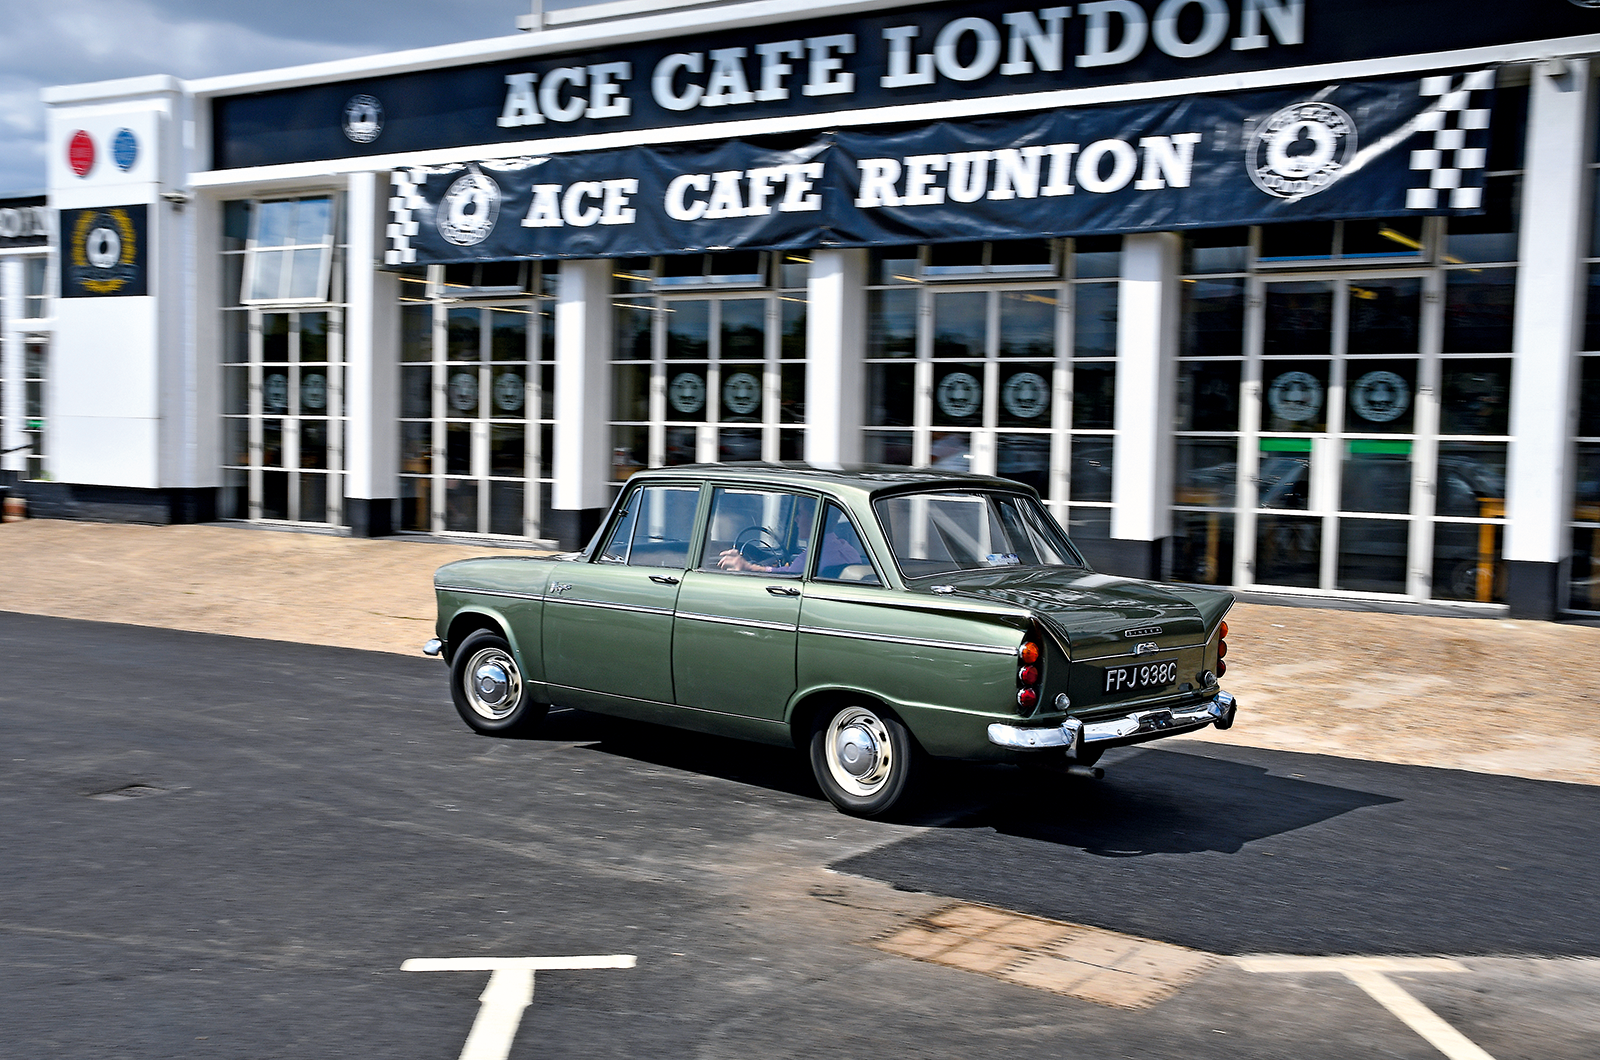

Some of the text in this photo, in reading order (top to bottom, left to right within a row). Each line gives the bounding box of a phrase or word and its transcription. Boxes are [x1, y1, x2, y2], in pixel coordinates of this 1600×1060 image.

[497, 0, 1305, 127] ACE CAFE LONDON
[521, 178, 639, 228] ACE
[664, 162, 824, 221] CAFE
[854, 132, 1202, 209] REUNION
[1106, 662, 1177, 692] FPJ 938C
